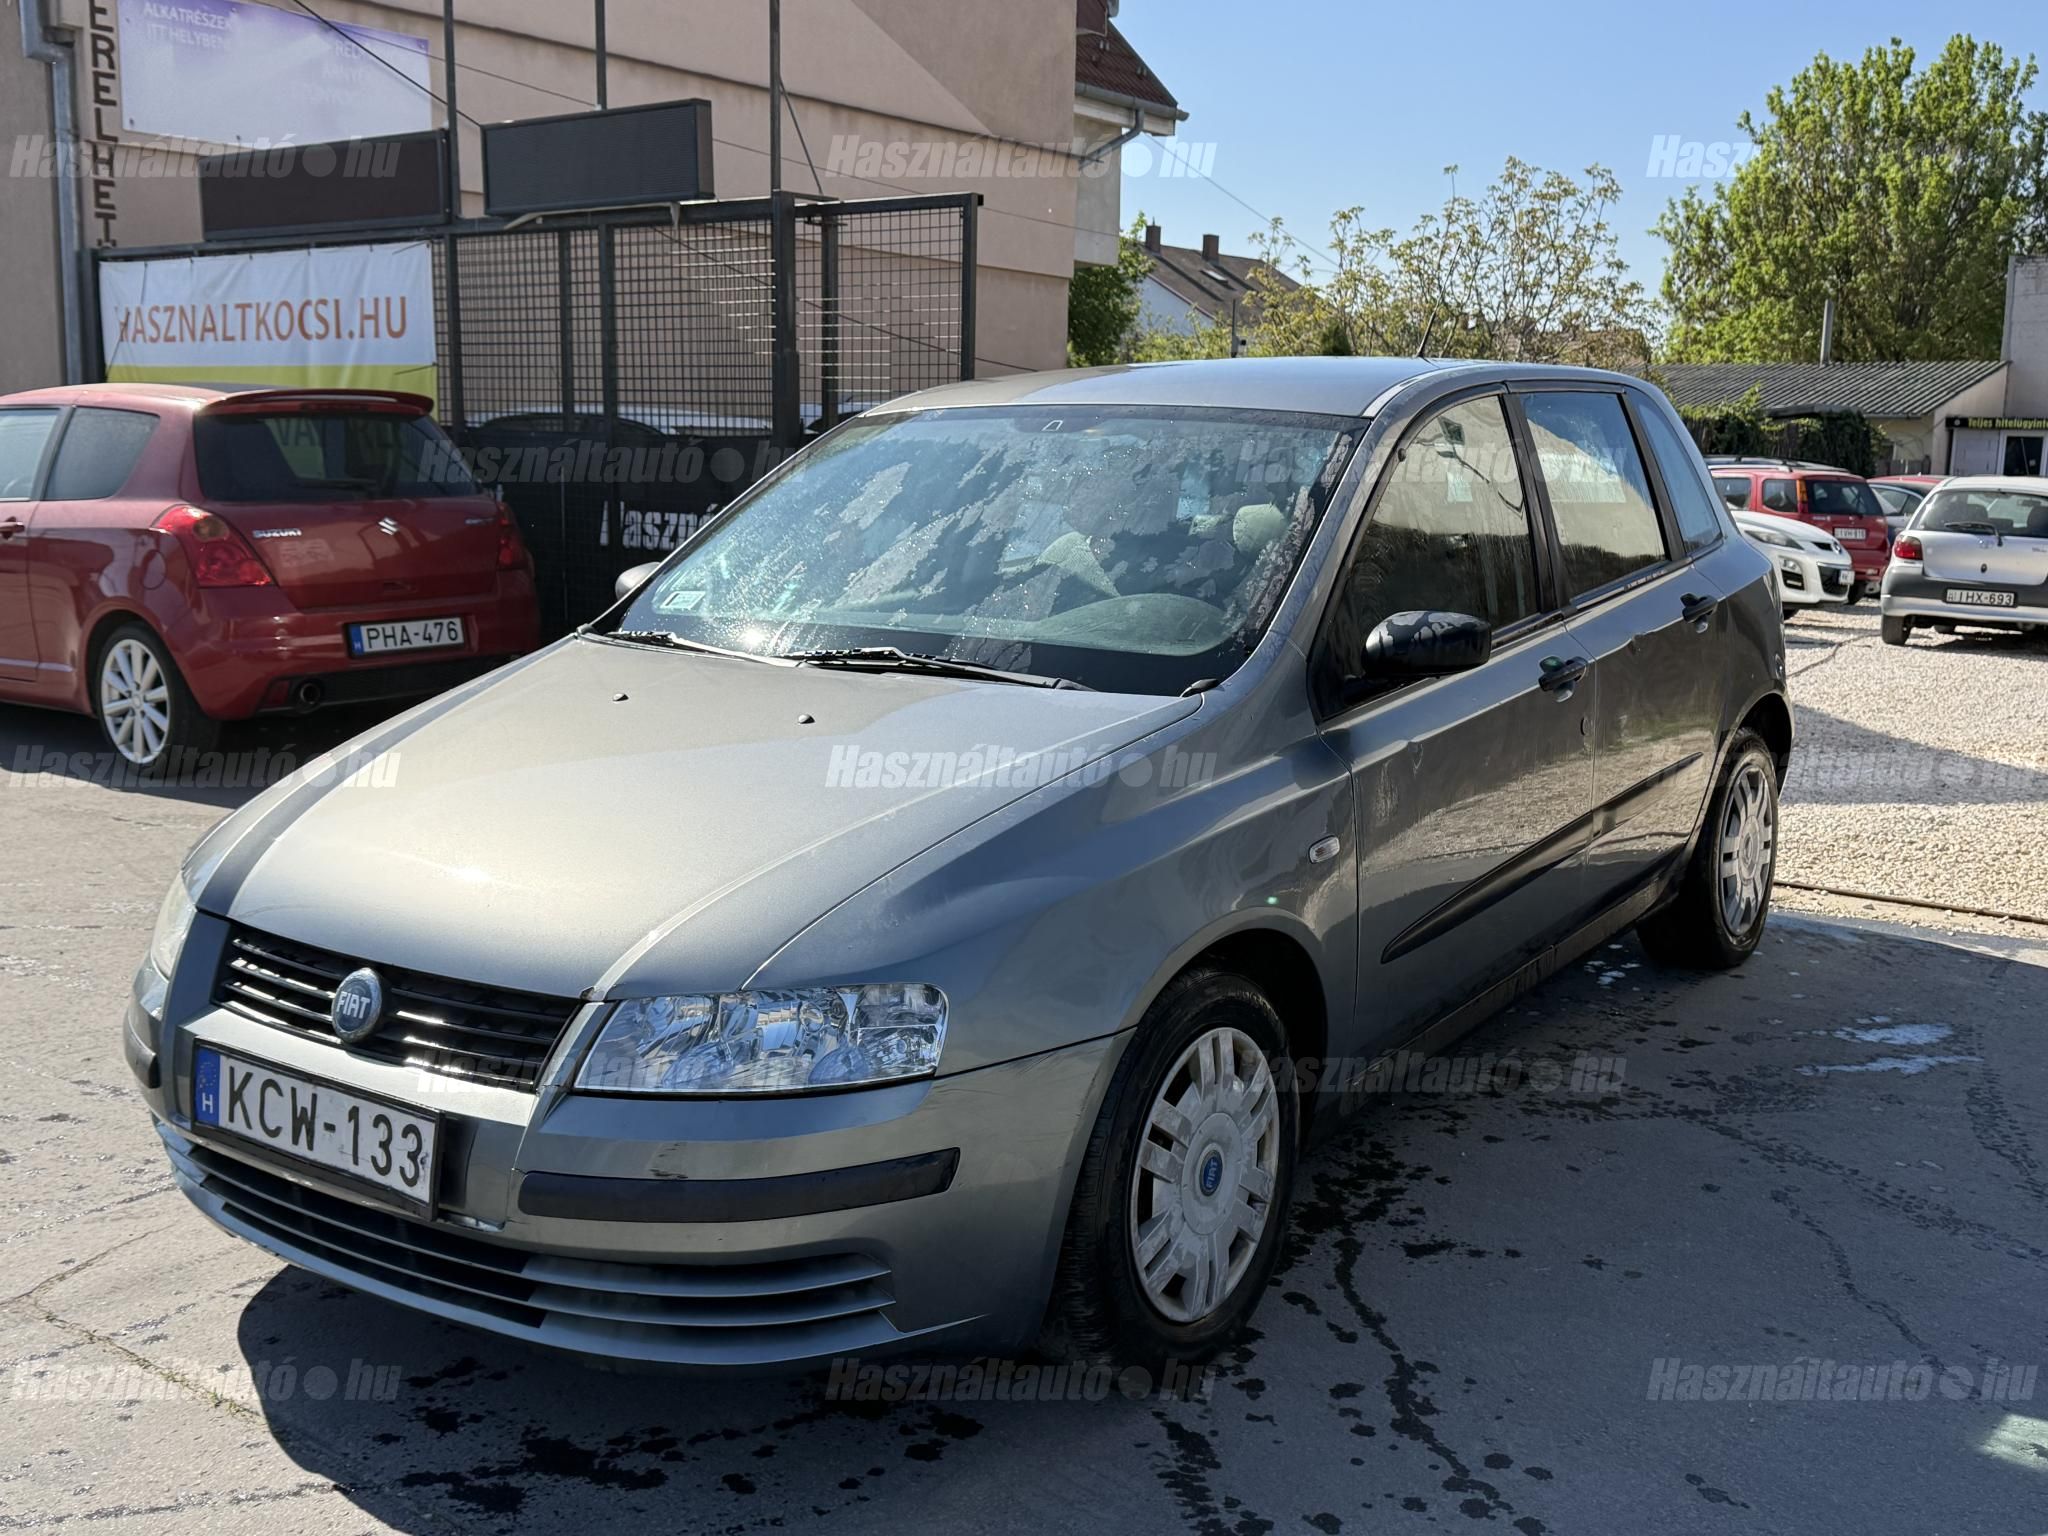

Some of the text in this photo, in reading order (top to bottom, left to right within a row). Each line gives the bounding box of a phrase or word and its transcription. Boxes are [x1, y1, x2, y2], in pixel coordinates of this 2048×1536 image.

[89, 0, 118, 248] ERELHET
[366, 620, 459, 649] PHA-476
[336, 990, 371, 1020] FIAT
[202, 1065, 423, 1188] H KCW-133
[1205, 1158, 1218, 1188] FIAT
